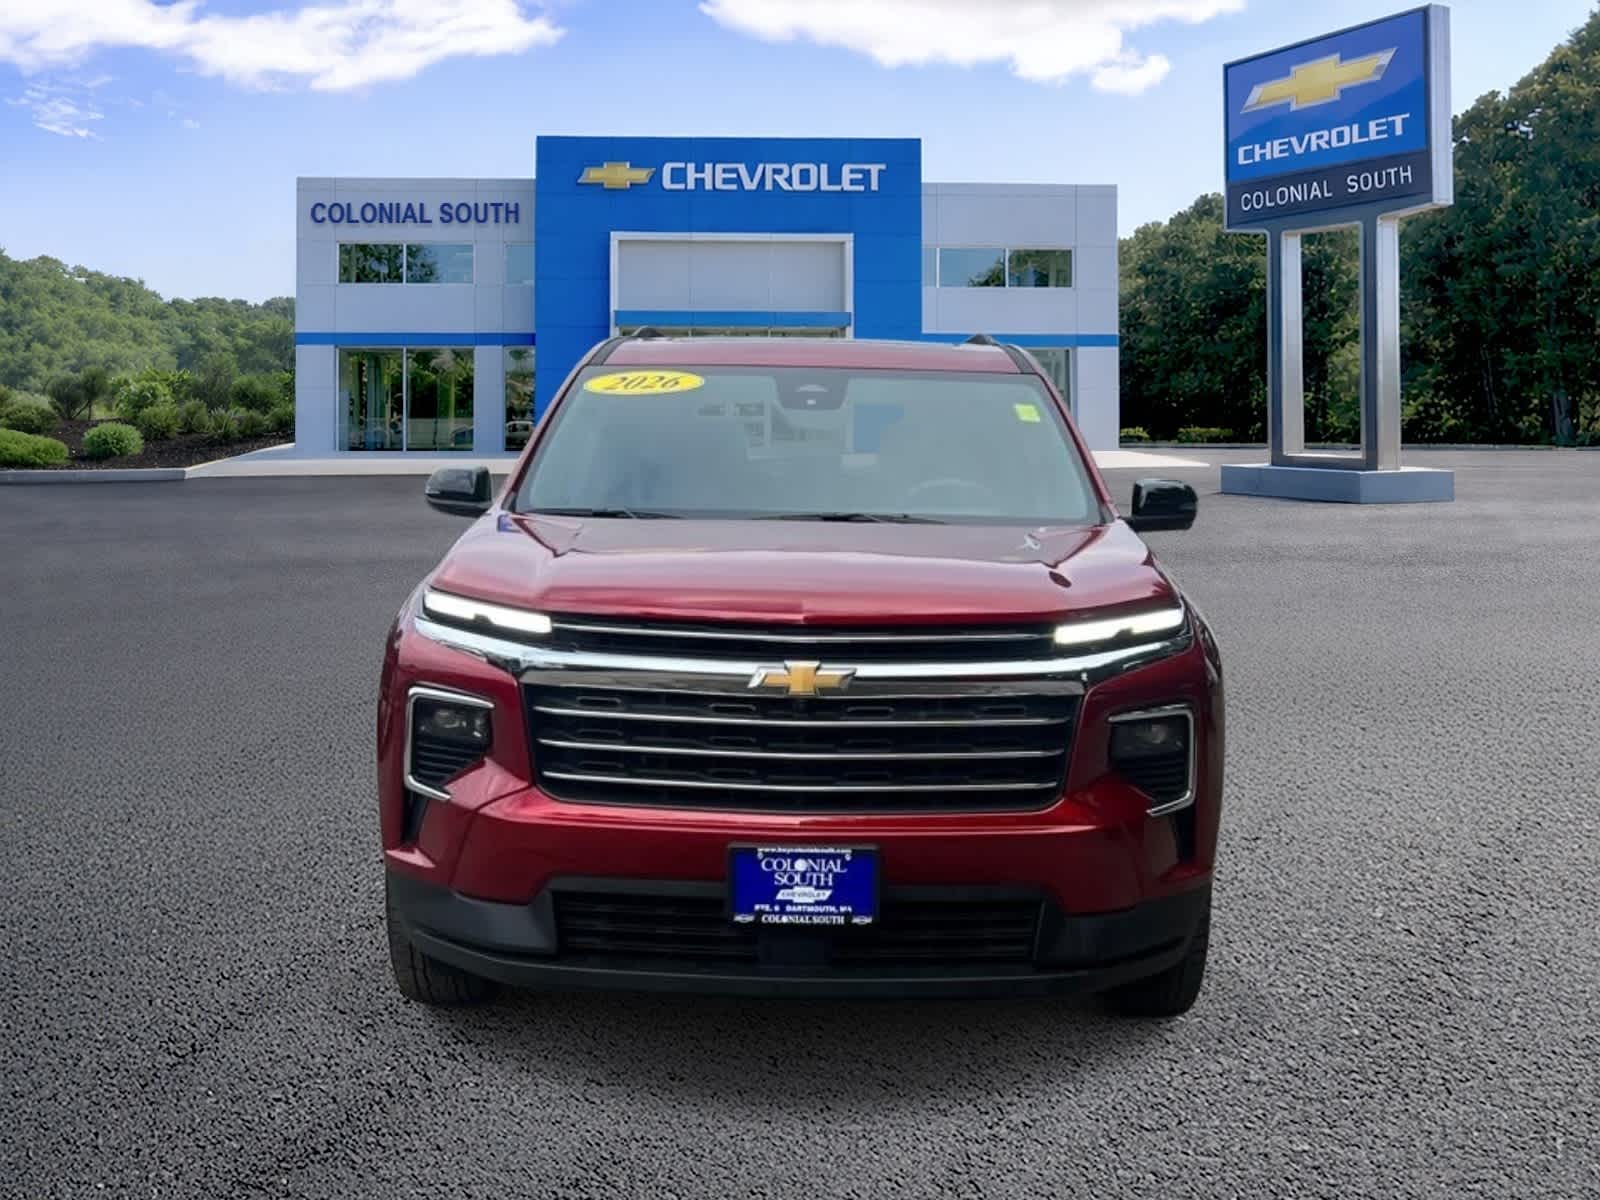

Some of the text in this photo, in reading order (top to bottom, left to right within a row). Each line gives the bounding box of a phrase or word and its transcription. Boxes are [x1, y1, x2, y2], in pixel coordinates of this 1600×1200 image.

[1238, 113, 1410, 165] CHEVROLET
[662, 162, 887, 192] CHEVROLET
[1241, 165, 1413, 211] COLONIAL SOUTH
[310, 202, 520, 224] COLONIAL SOUTH
[602, 375, 681, 391] 2026
[761, 858, 848, 873] COLONIAL
[774, 872, 833, 886] SOUTH
